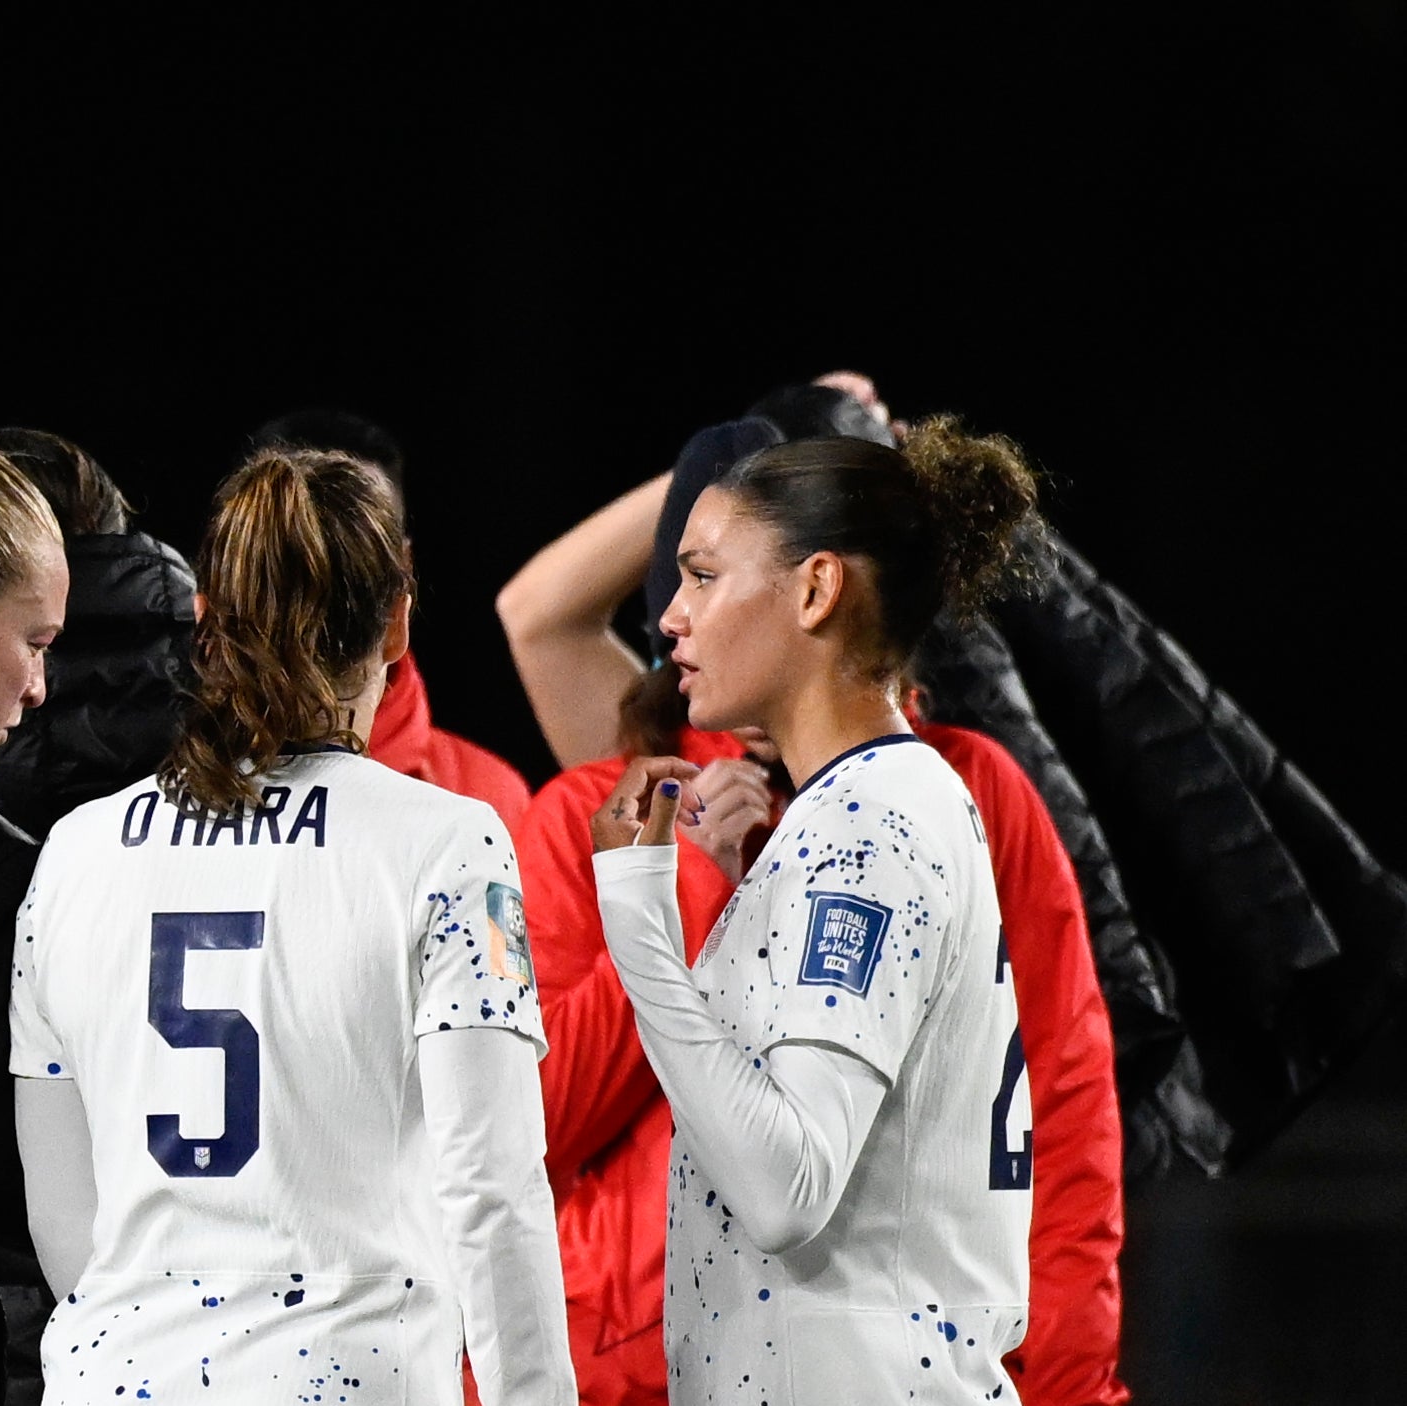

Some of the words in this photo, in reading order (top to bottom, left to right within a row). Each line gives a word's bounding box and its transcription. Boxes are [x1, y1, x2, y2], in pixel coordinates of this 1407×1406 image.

[121, 784, 329, 848] OHARA
[825, 907, 869, 931] FOOTBALL
[822, 920, 867, 947] UNITES
[826, 958, 846, 969] FIFA
[146, 911, 265, 1178] 5
